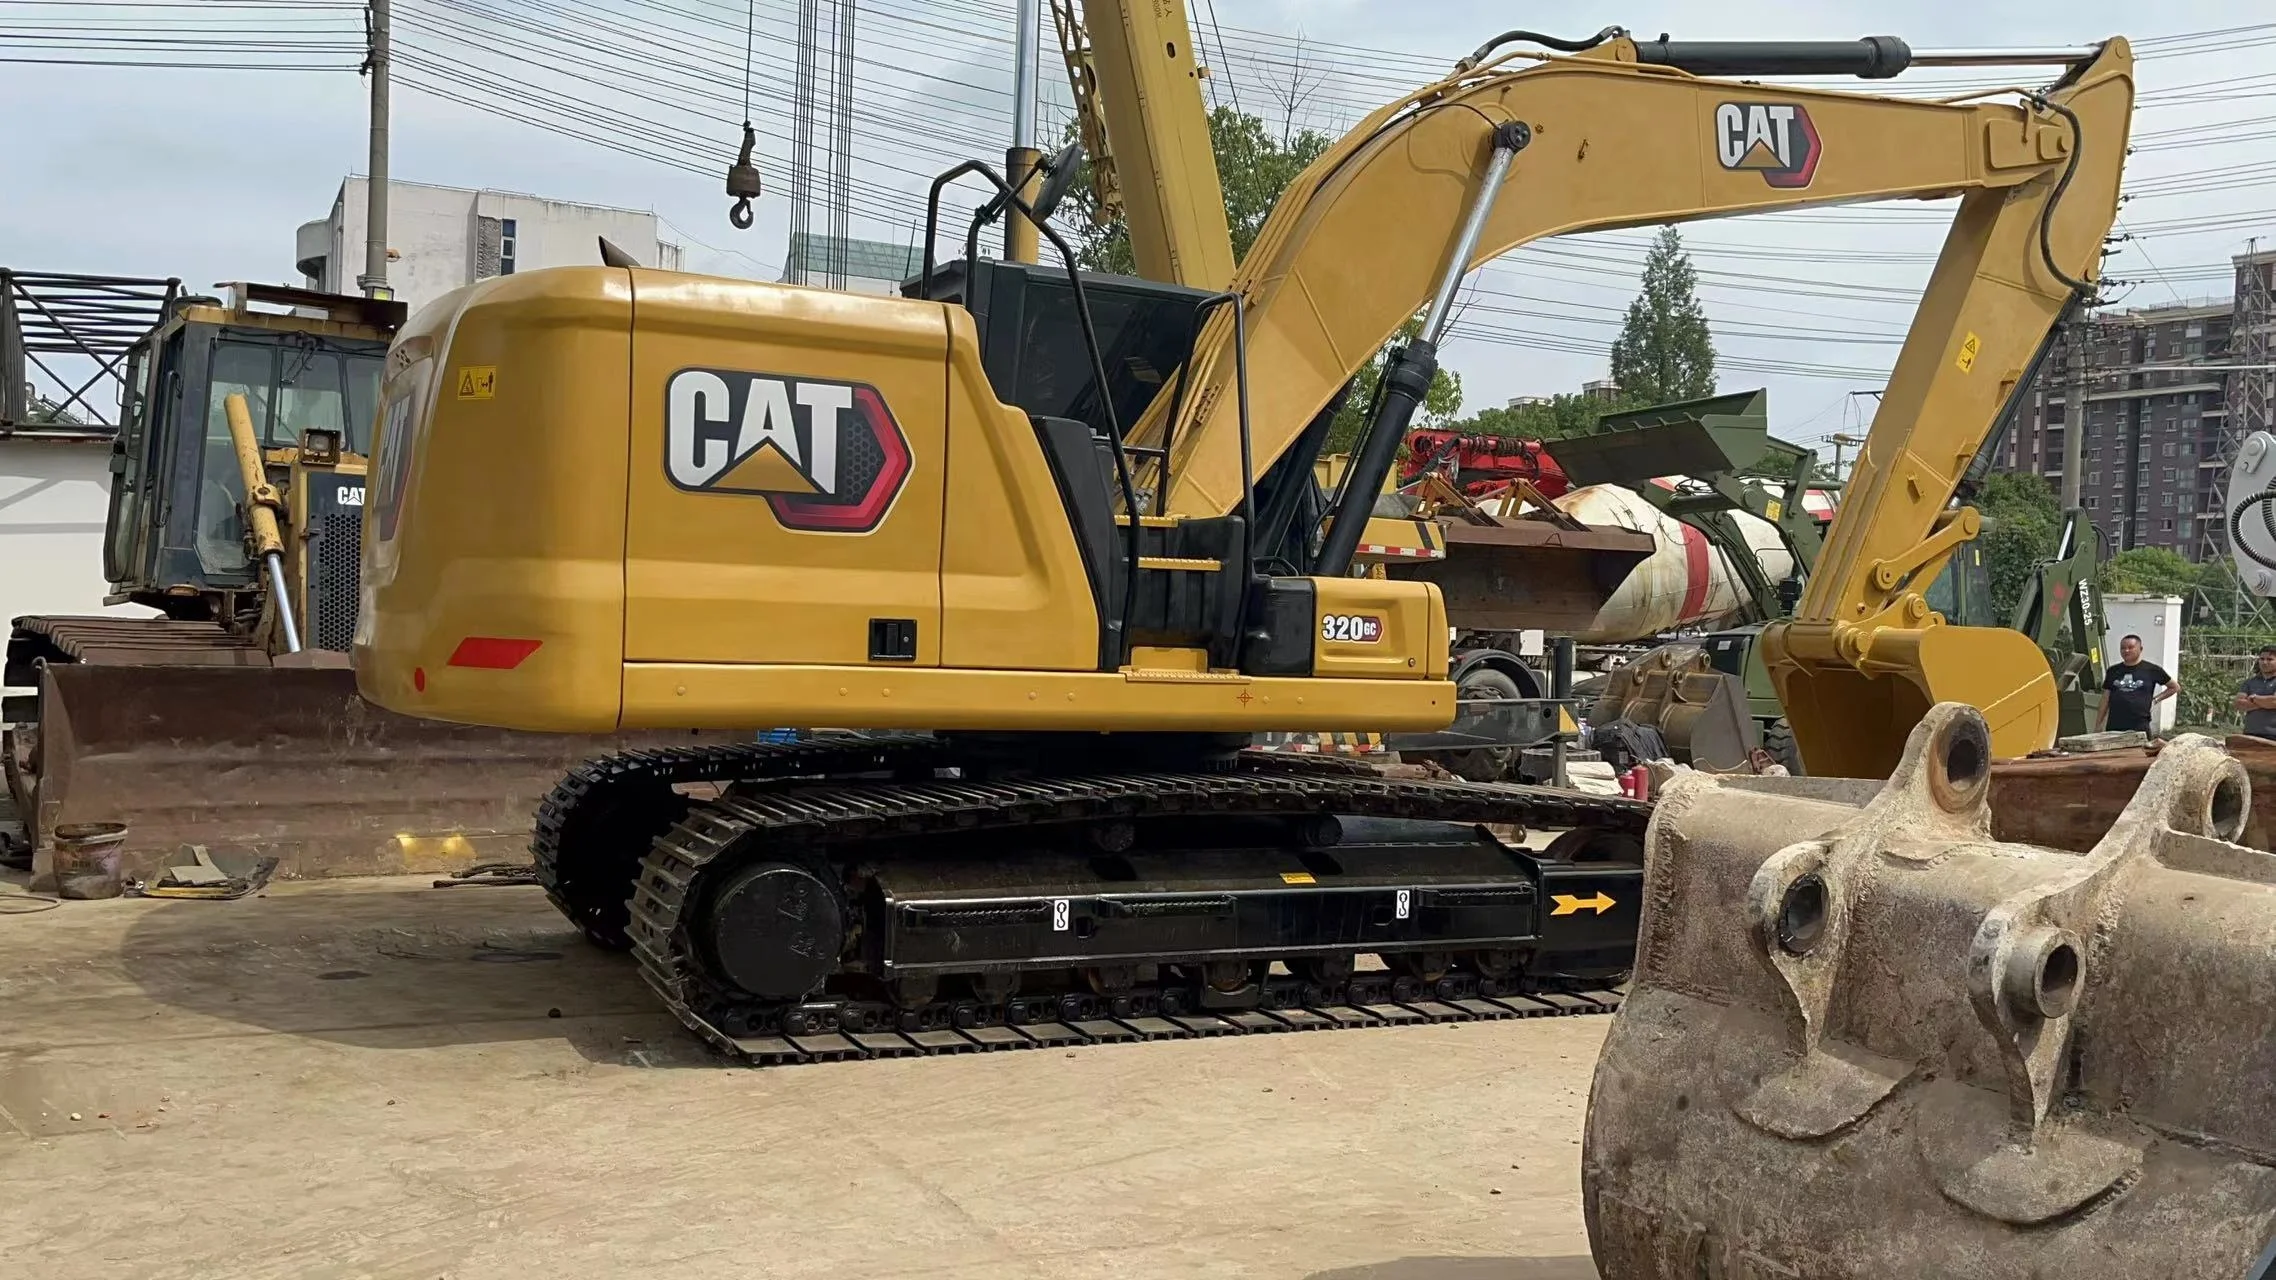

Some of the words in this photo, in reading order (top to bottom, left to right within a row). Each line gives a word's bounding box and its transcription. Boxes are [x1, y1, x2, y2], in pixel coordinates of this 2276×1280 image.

[1717, 103, 1795, 168] CAT
[669, 371, 852, 495] CAT
[2079, 578, 2093, 626] WZ30-25
